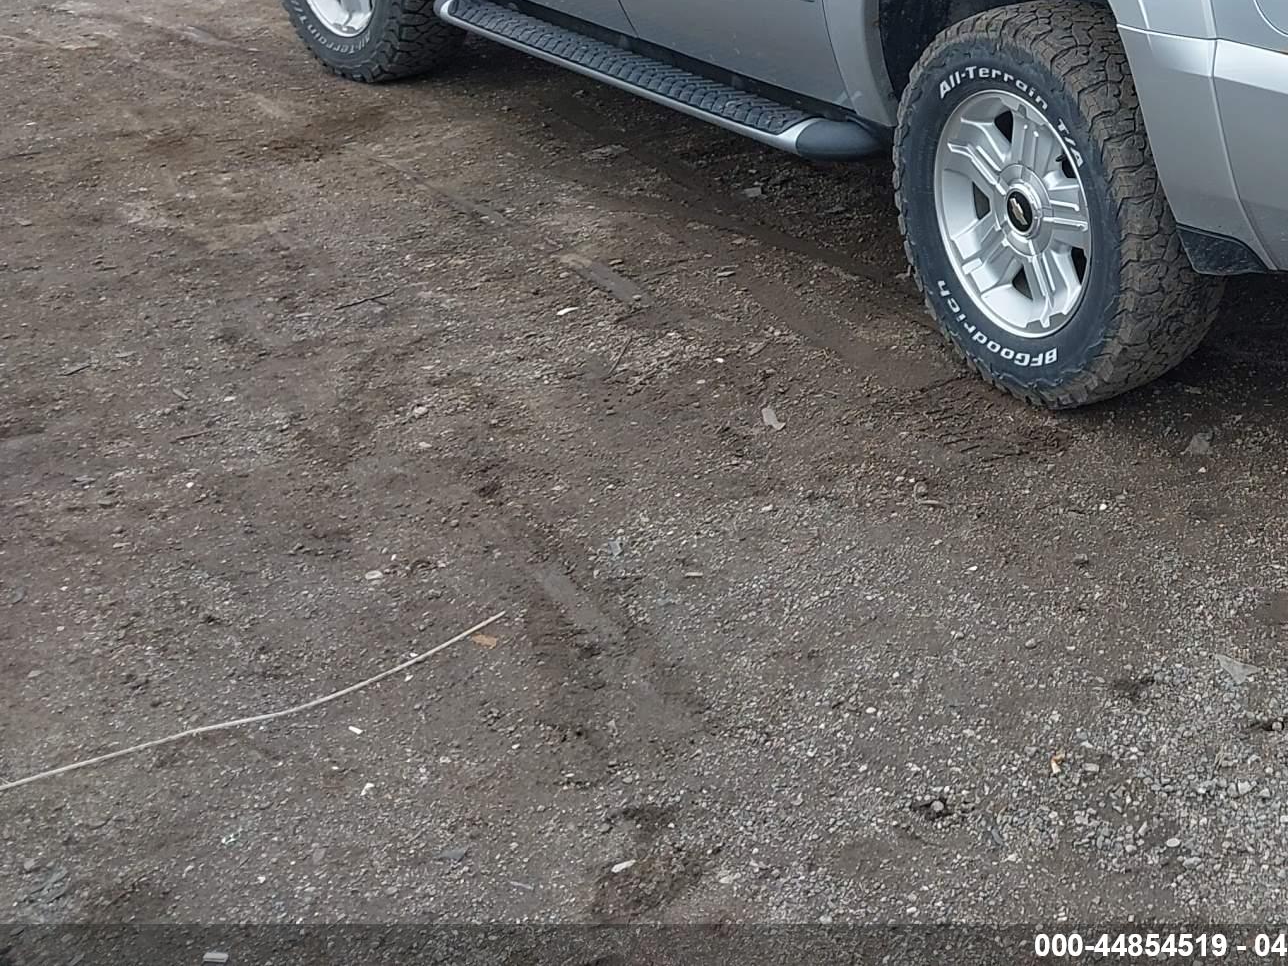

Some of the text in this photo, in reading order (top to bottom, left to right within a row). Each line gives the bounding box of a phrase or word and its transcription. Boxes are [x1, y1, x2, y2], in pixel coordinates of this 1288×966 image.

[938, 64, 1085, 168] All-Terrain T/A
[936, 279, 1058, 368] BFGoodrich
